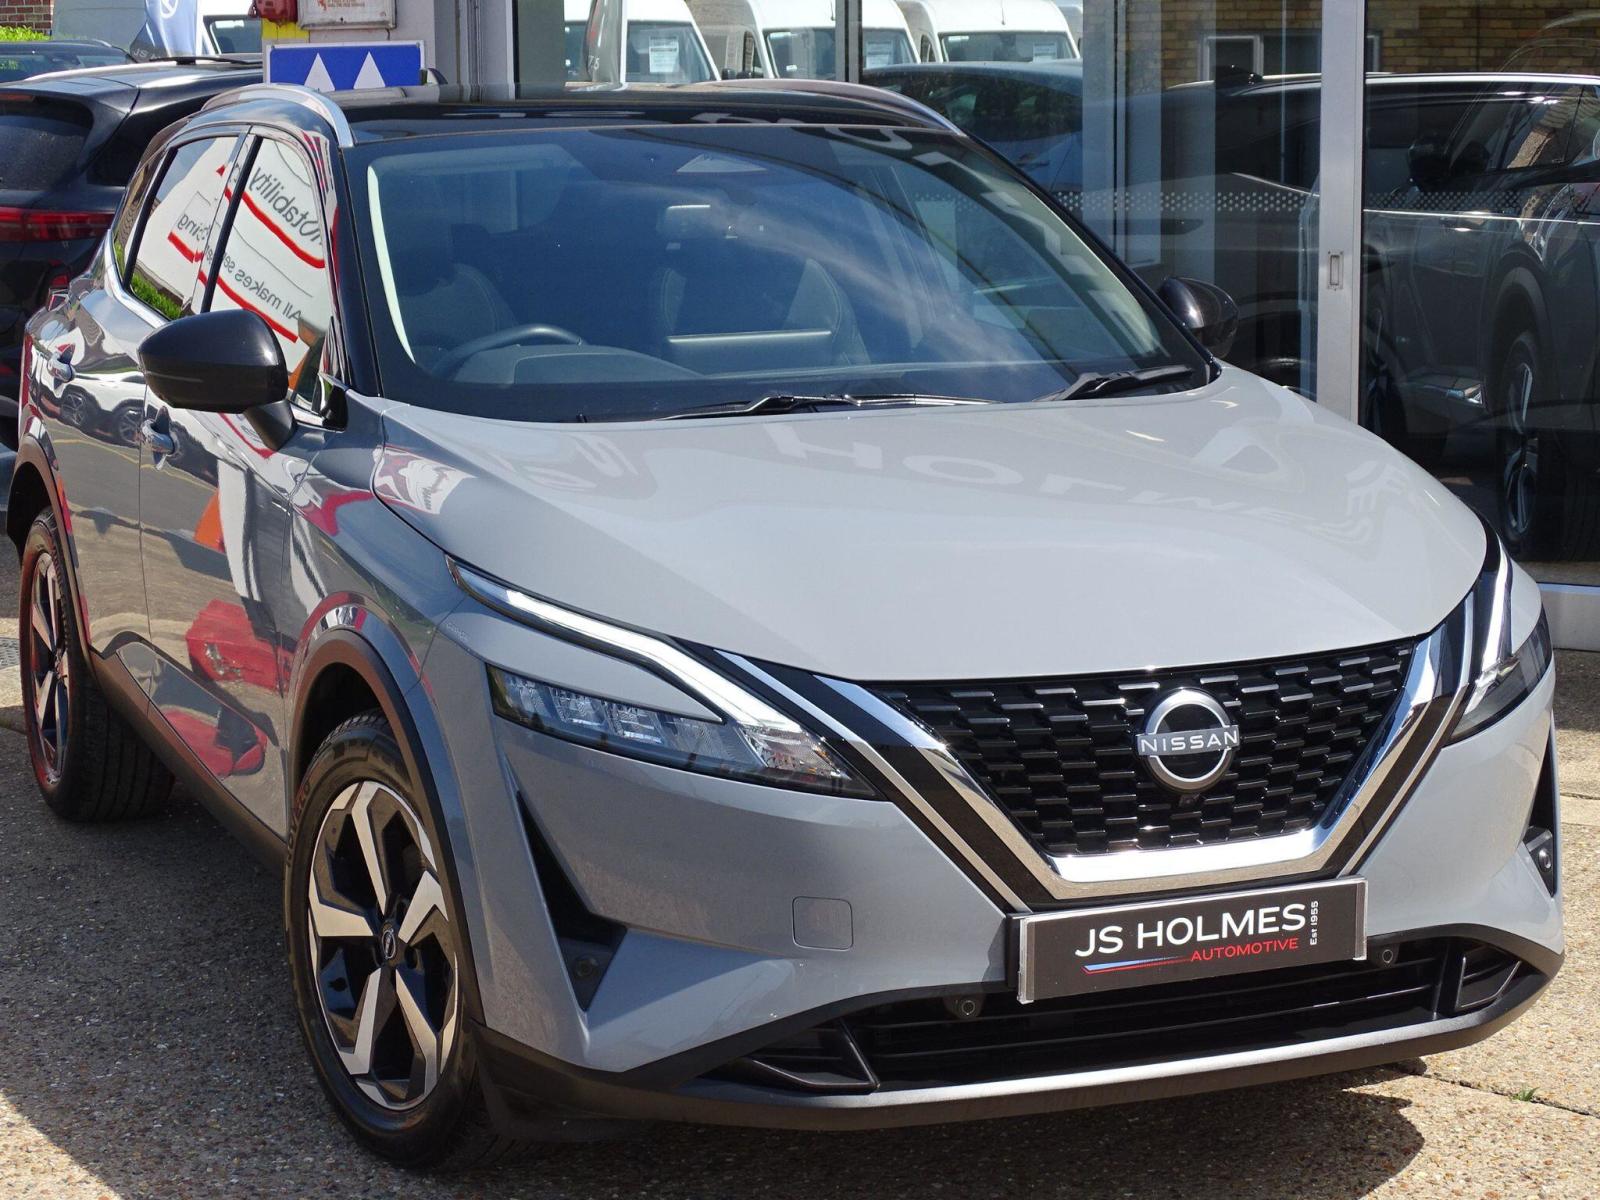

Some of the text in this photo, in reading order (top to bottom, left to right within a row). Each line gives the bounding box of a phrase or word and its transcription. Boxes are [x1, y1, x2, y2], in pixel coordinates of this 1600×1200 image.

[1141, 730, 1238, 753] NISSAN
[1075, 903, 1306, 957] JS HOLMES
[1309, 900, 1319, 946] Est 1955
[1190, 937, 1299, 962] AUTOMOTIVE
